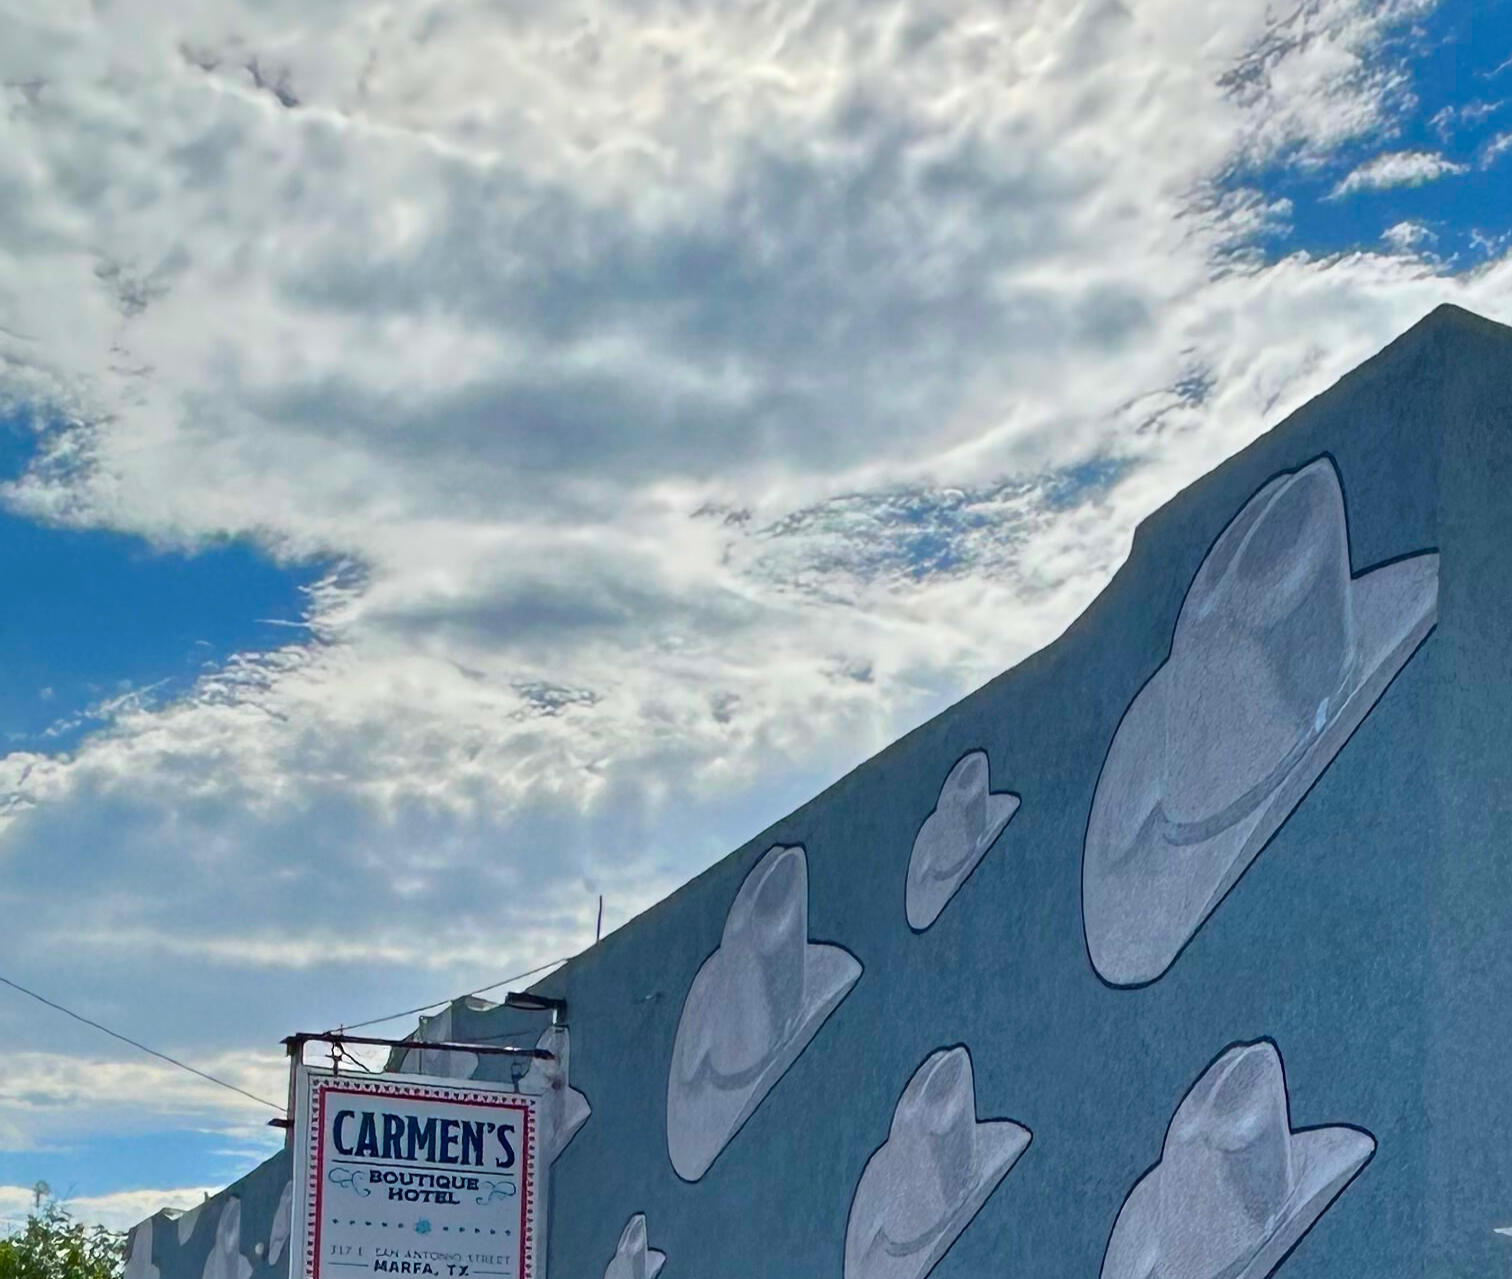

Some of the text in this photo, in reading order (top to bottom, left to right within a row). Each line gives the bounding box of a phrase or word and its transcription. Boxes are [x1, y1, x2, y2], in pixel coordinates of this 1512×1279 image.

[332, 1110, 515, 1168] CARMEN'S
[369, 1169, 479, 1191] BOUTIQUE
[388, 1187, 460, 1205] HOTEL
[374, 1259, 469, 1277] MARFA, TX
